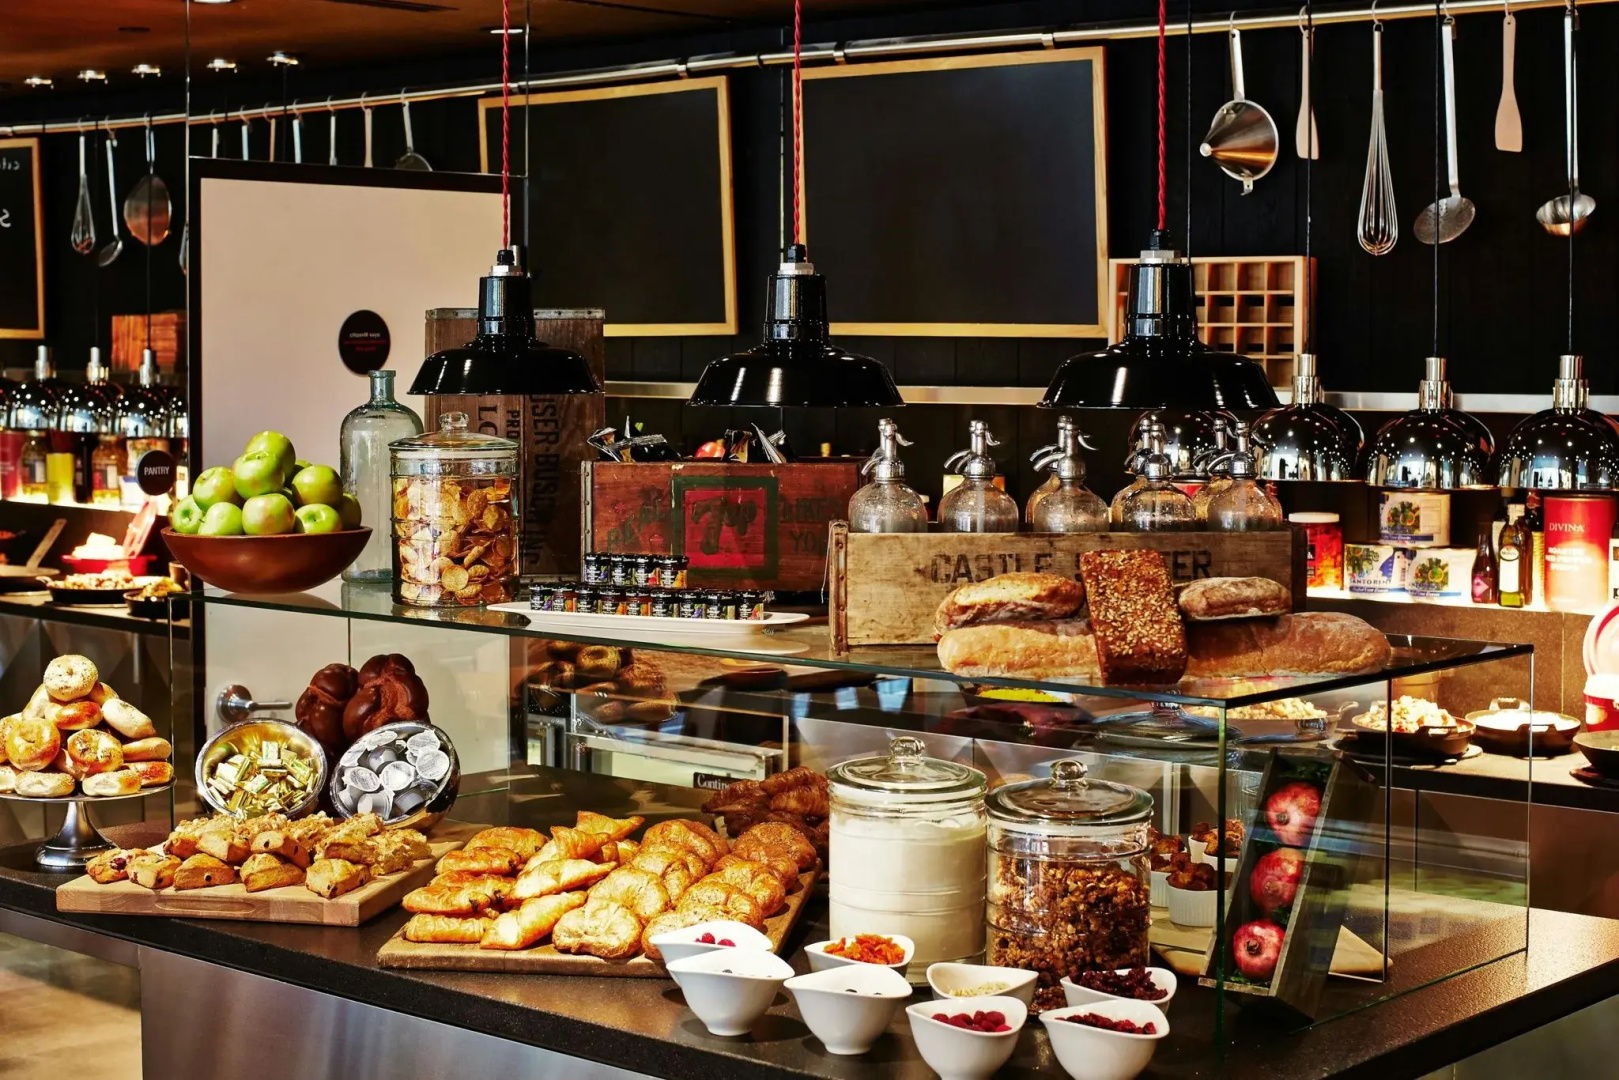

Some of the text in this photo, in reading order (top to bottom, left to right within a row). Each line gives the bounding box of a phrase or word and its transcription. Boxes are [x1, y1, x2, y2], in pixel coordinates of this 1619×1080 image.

[144, 466, 170, 476] PANTRY
[1549, 522, 1585, 533] DIVINA
[930, 552, 1053, 584] CASTLE
